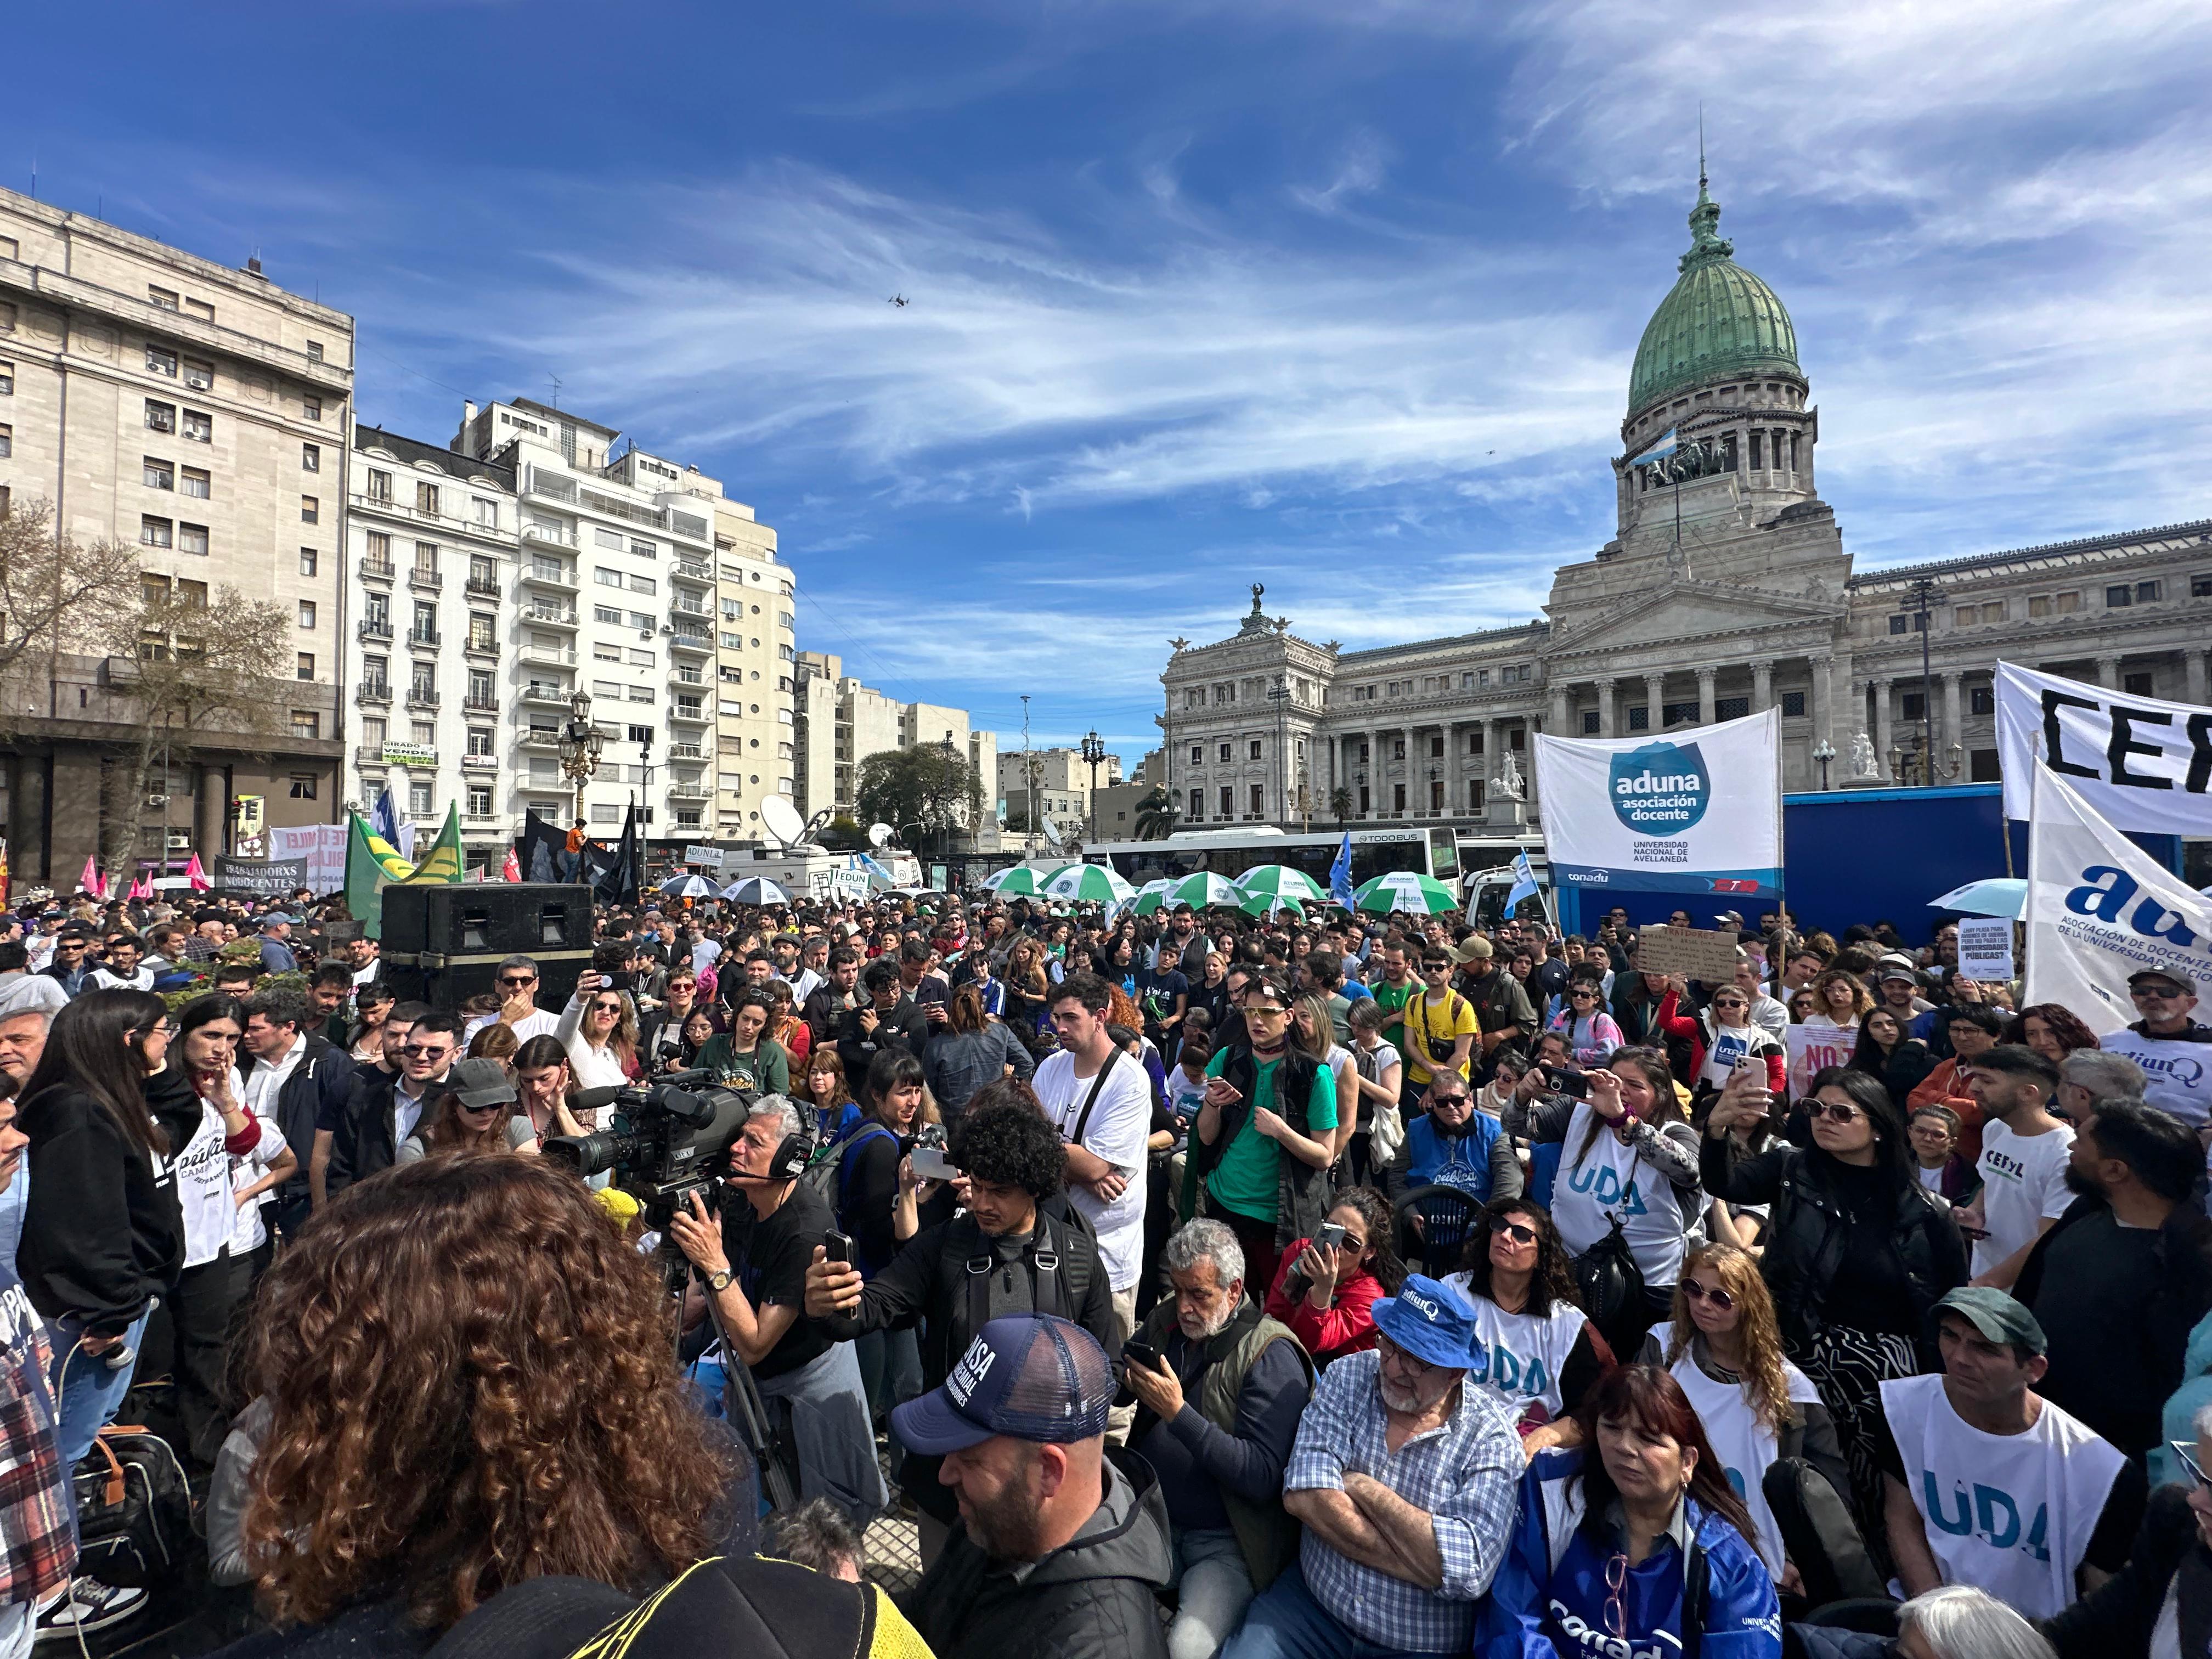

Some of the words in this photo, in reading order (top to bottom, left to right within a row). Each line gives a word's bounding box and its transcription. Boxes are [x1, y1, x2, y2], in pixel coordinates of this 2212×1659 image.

[1616, 770, 1700, 794] aduna
[1622, 794, 1697, 808] asociación
[1631, 809, 1689, 821] docente
[225, 864, 297, 877] TRABAJADORXS
[1568, 872, 1609, 883] conadu
[1662, 927, 1716, 940] TRAIDORES
[2061, 916, 2126, 943] ASOCIACIÓN
[2128, 938, 2145, 949] DE
[2147, 944, 2212, 970] DOCENTE
[2058, 925, 2069, 935] DE
[2072, 930, 2082, 940] LA
[2084, 934, 2165, 965] UNIVERSIDAD
[1805, 1044, 1837, 1071] NO
[1568, 1164, 1648, 1215] UDA
